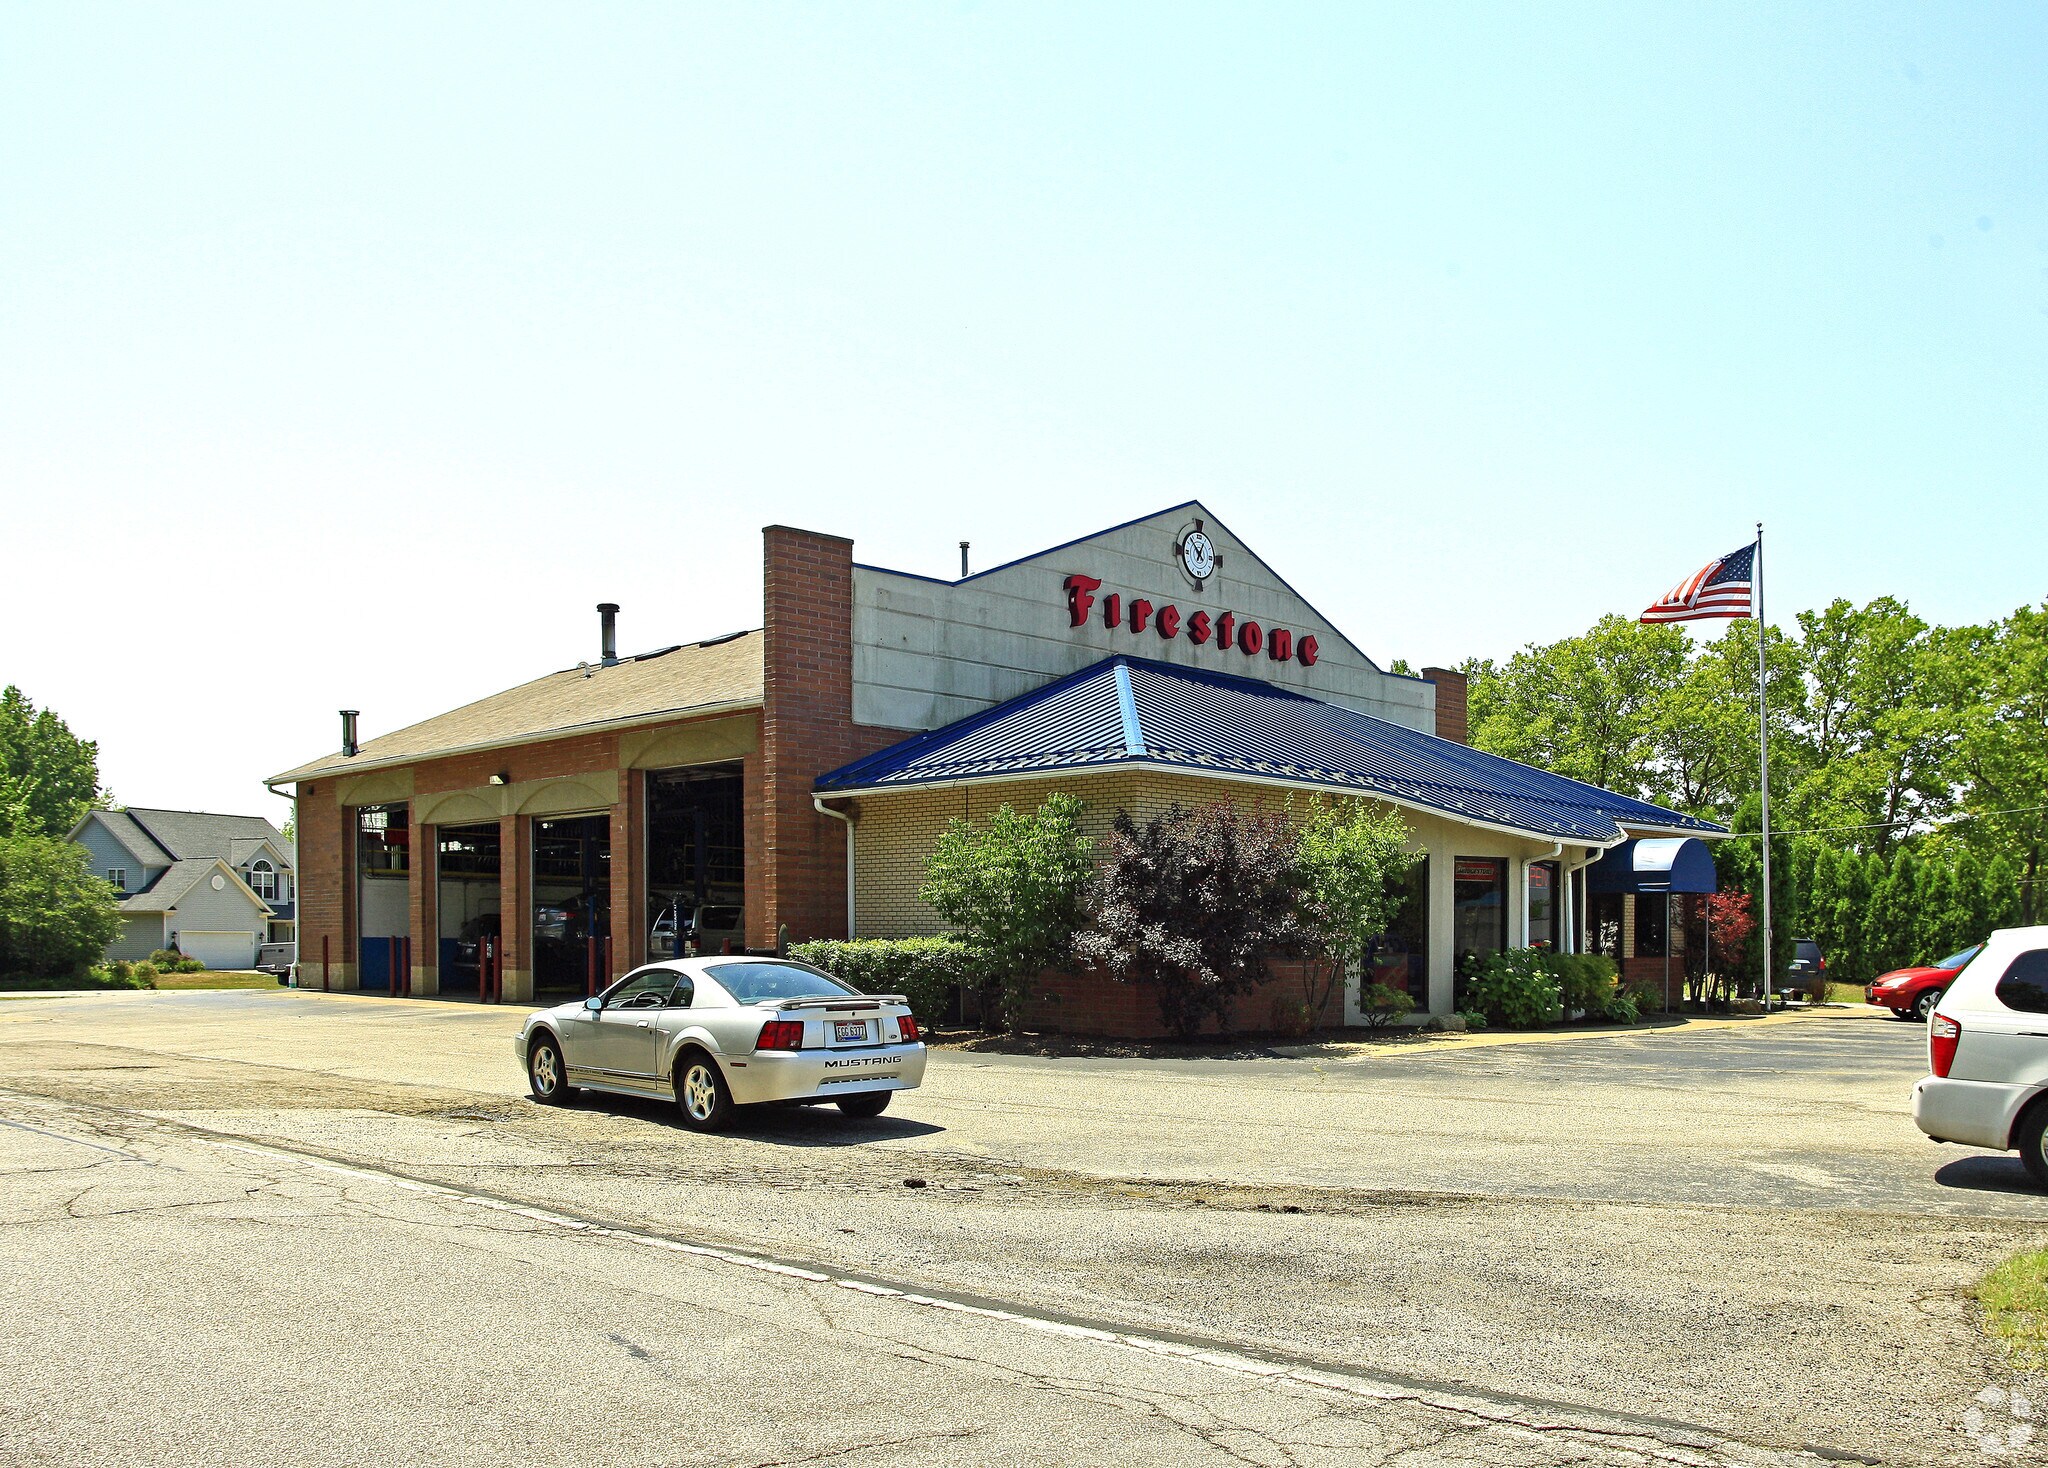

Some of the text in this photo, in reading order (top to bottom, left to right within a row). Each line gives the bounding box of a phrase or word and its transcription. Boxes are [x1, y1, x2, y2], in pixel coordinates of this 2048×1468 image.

[1063, 574, 1319, 667] Firestone
[1529, 867, 1549, 887] PEN
[824, 1055, 902, 1068] MUSTANG
